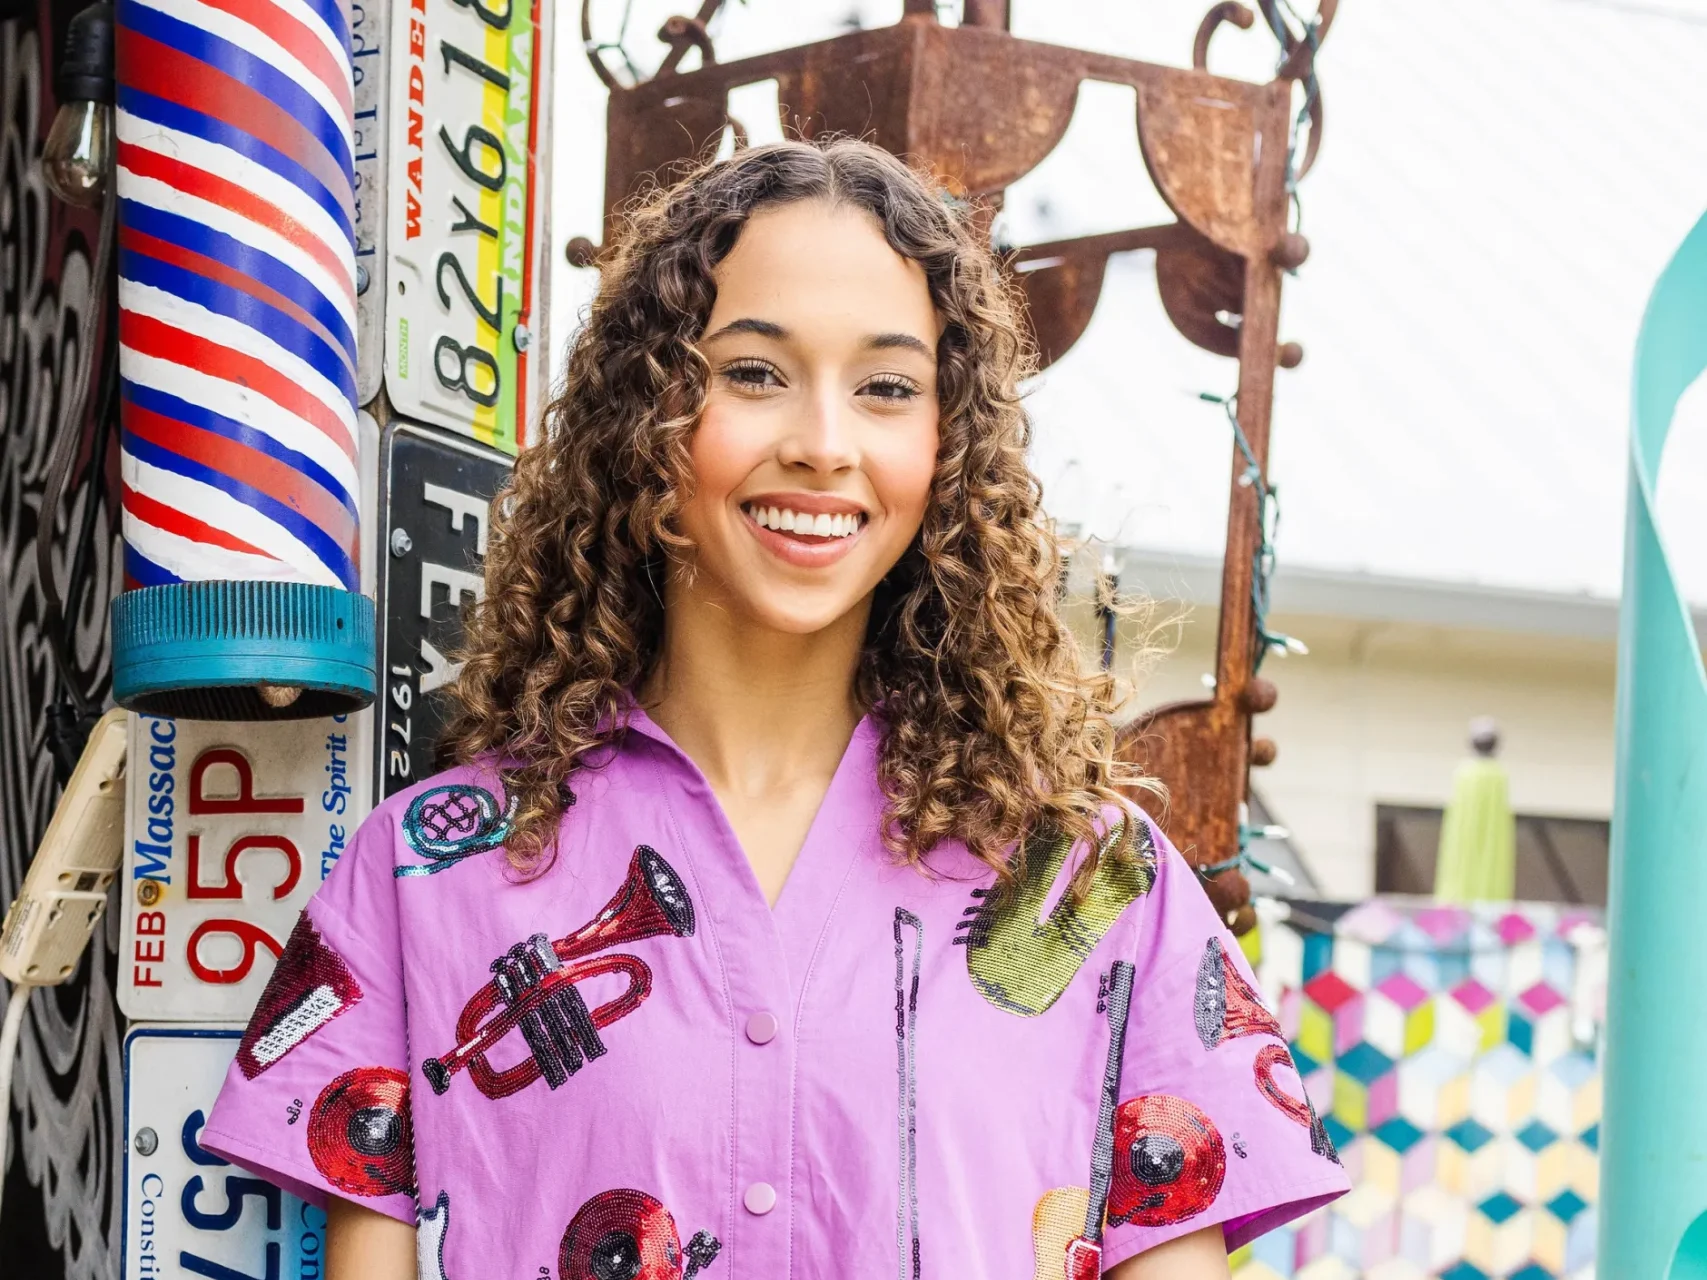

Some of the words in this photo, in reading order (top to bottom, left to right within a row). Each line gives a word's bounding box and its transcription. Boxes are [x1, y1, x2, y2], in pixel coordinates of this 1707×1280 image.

[503, 30, 530, 299] INDIANA
[400, 317, 408, 379] MONTH
[322, 733, 351, 815] Spirit
[391, 665, 411, 777] 1972
[134, 712, 176, 885] Massac
[187, 749, 304, 985] 95P
[133, 911, 165, 987] FEB
